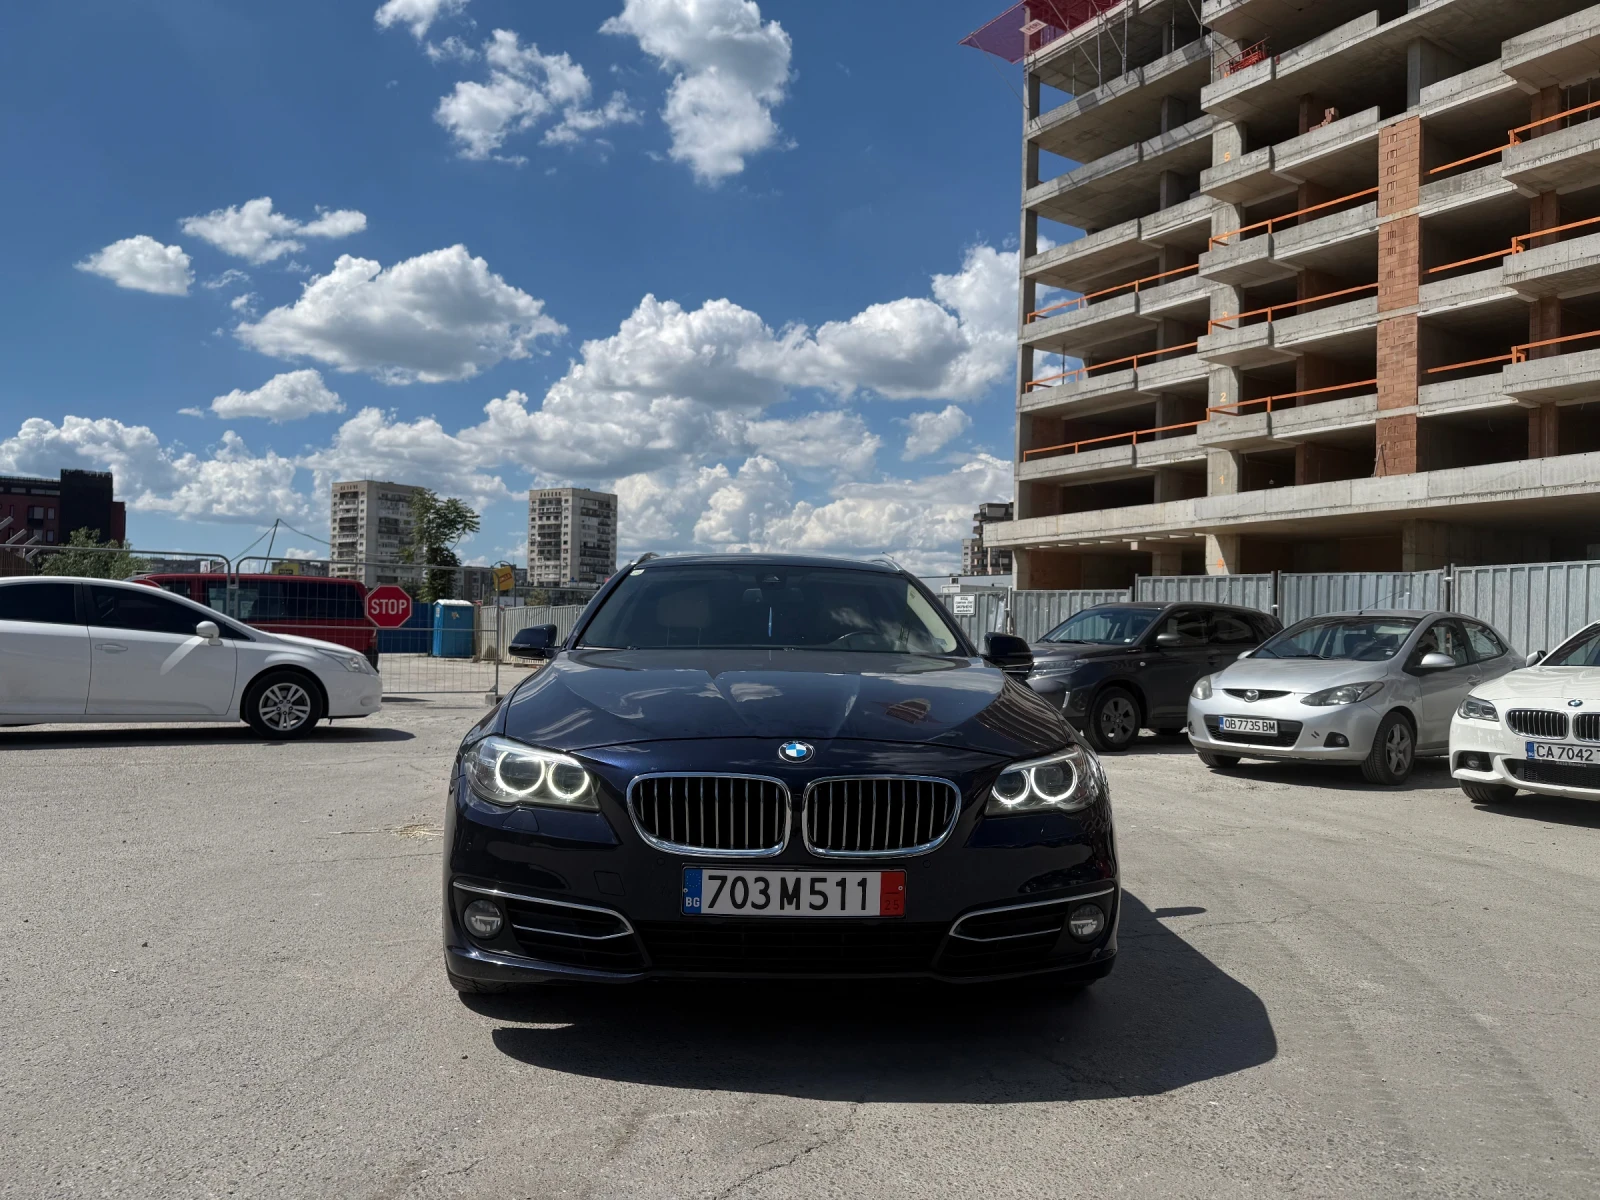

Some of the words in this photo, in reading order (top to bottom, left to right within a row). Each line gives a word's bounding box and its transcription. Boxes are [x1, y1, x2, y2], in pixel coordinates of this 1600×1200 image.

[1220, 392, 1227, 402] 2
[371, 599, 407, 614] STOP
[685, 897, 700, 907] BG
